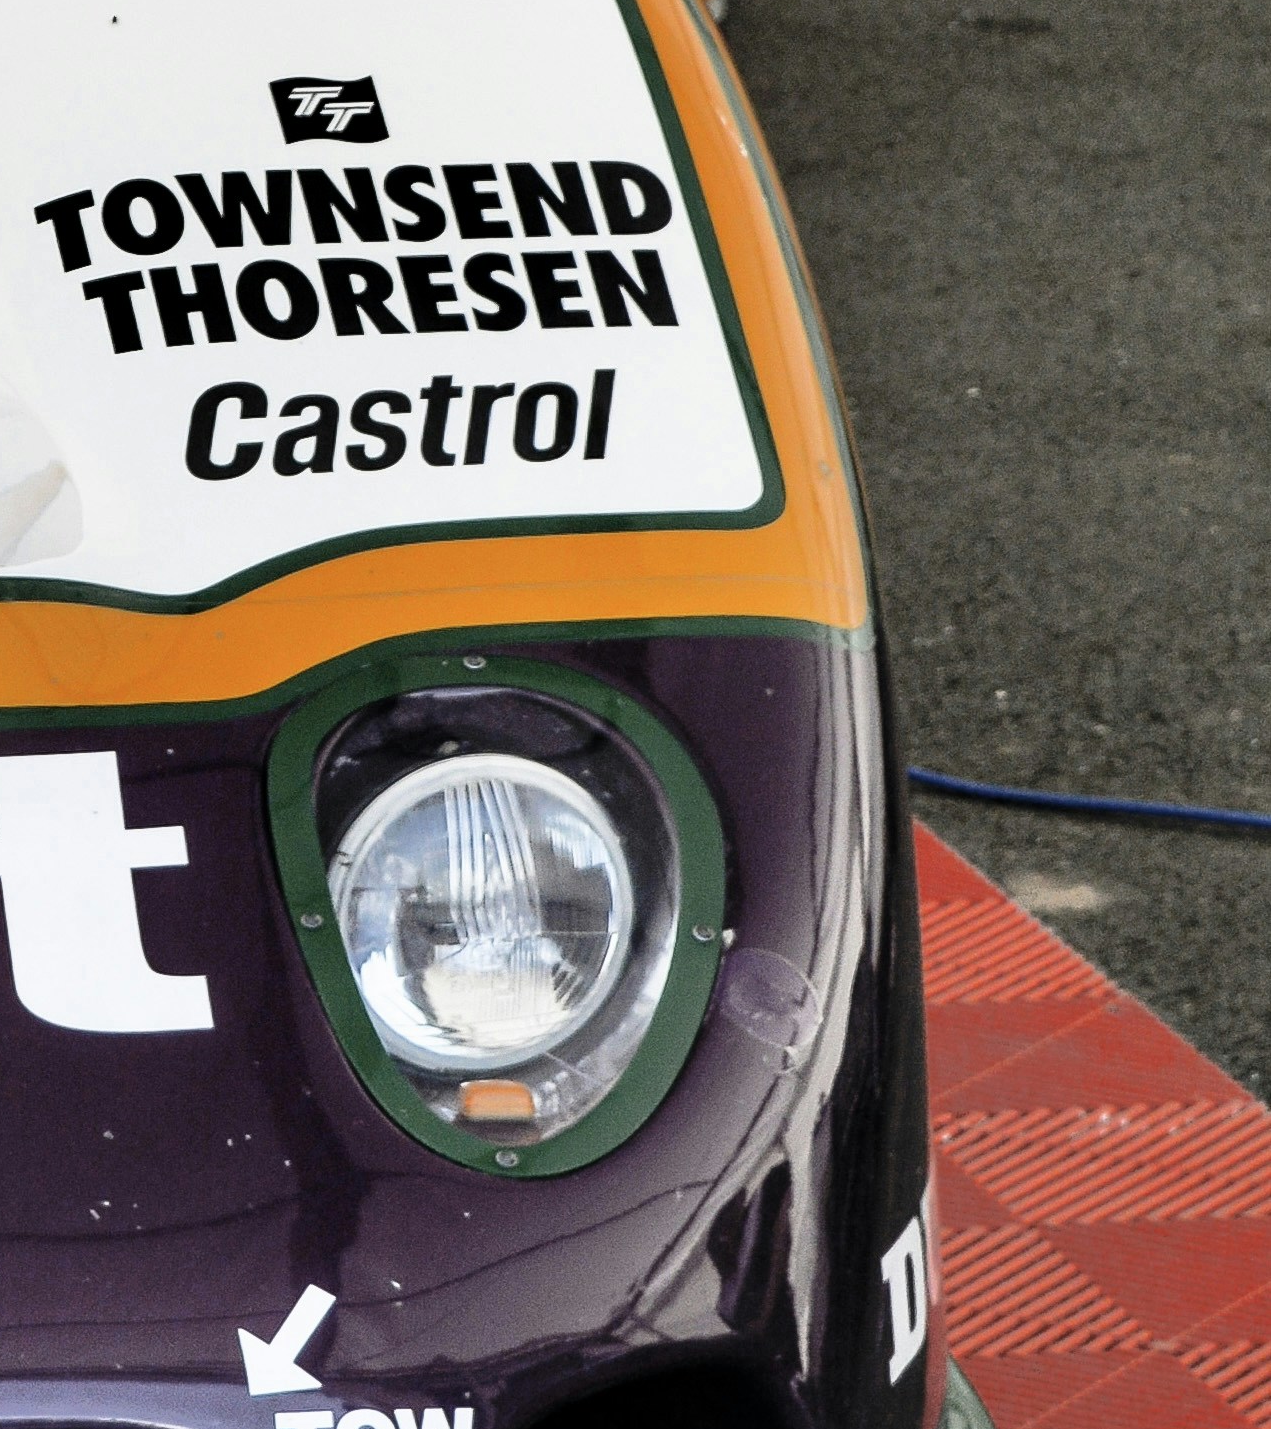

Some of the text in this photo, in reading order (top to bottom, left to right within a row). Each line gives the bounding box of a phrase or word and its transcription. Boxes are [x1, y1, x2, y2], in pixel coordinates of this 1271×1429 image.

[34, 160, 674, 274] TOWNSEND
[82, 249, 681, 355] THORESEN
[184, 367, 617, 482] Castrol
